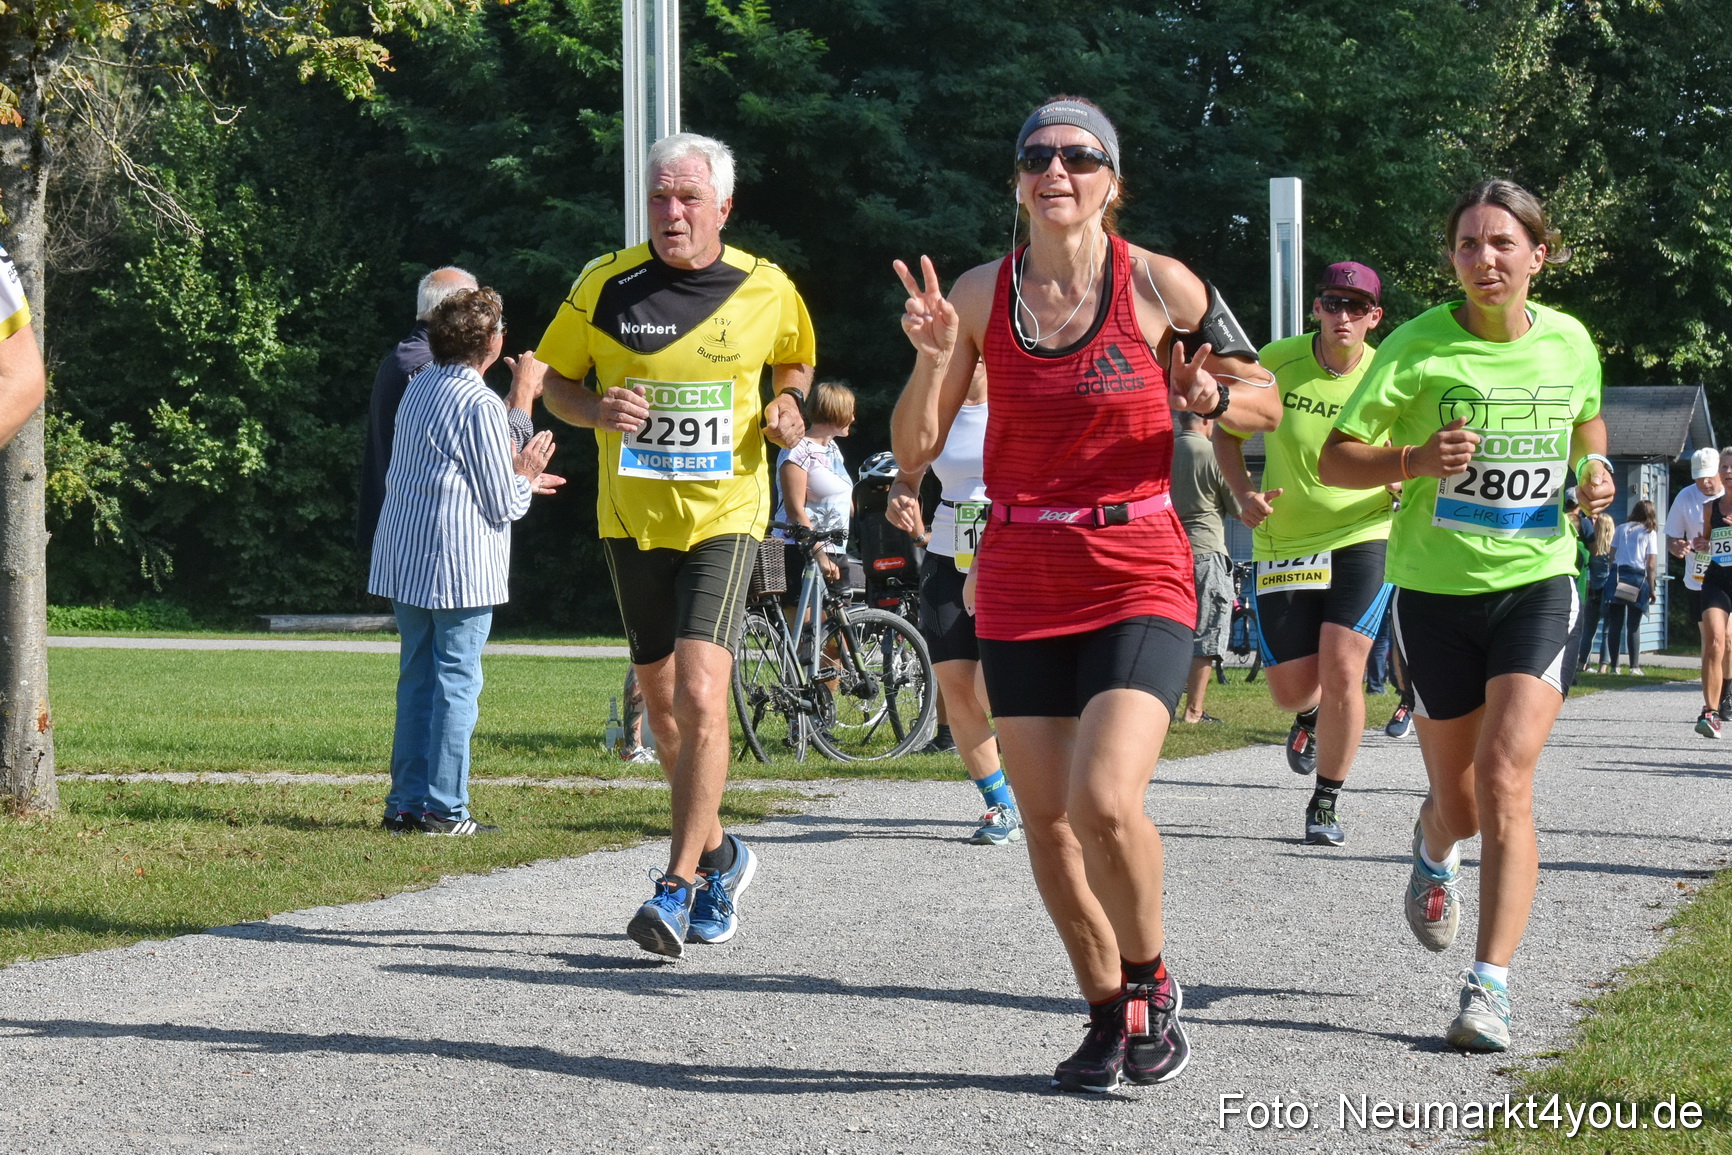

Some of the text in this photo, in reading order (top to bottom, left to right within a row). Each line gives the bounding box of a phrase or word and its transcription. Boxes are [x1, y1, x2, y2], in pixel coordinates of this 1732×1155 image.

[618, 268, 648, 285] STANNO
[621, 322, 677, 335] Norbert
[697, 347, 741, 363] Burgthann
[1075, 375, 1145, 395] adidas
[1283, 392, 1345, 419] CRAF
[636, 417, 718, 446] 2291
[637, 454, 718, 469] NORBERT
[1454, 466, 1550, 500] 2802
[1454, 506, 1549, 525] CHRISTINE
[1262, 572, 1322, 586] CHRISTIAN
